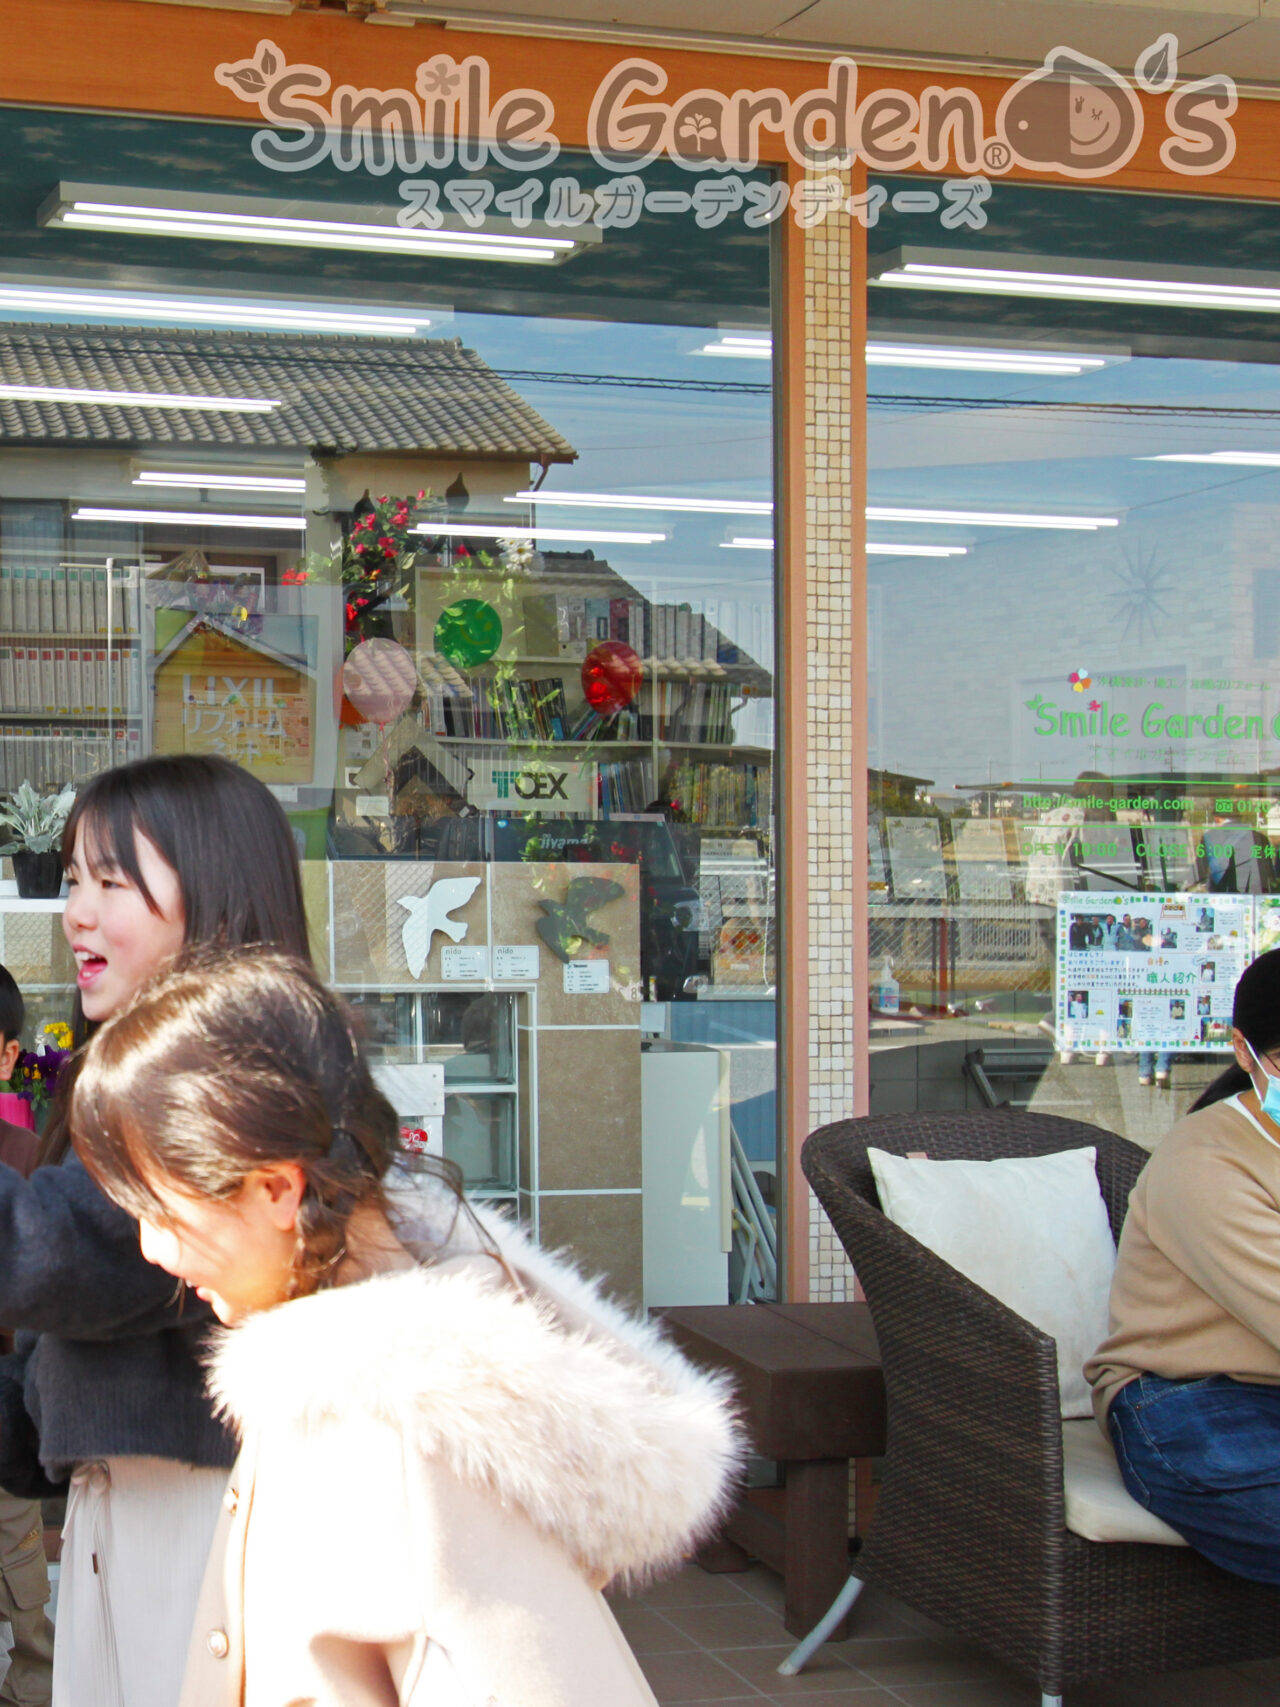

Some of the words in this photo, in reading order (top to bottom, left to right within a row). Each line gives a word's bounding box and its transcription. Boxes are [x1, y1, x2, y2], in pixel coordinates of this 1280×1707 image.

[181, 673, 288, 708] LIXIL
[1034, 700, 1131, 738] Smile
[1140, 701, 1265, 740] Garden
[1022, 794, 1195, 811] http://smile-garden.com
[1021, 842, 1066, 857] OPEN
[1073, 843, 1118, 858] 10:00
[1135, 843, 1189, 858] CLOSE
[1195, 844, 1234, 859] 6:00
[497, 945, 514, 955] nido
